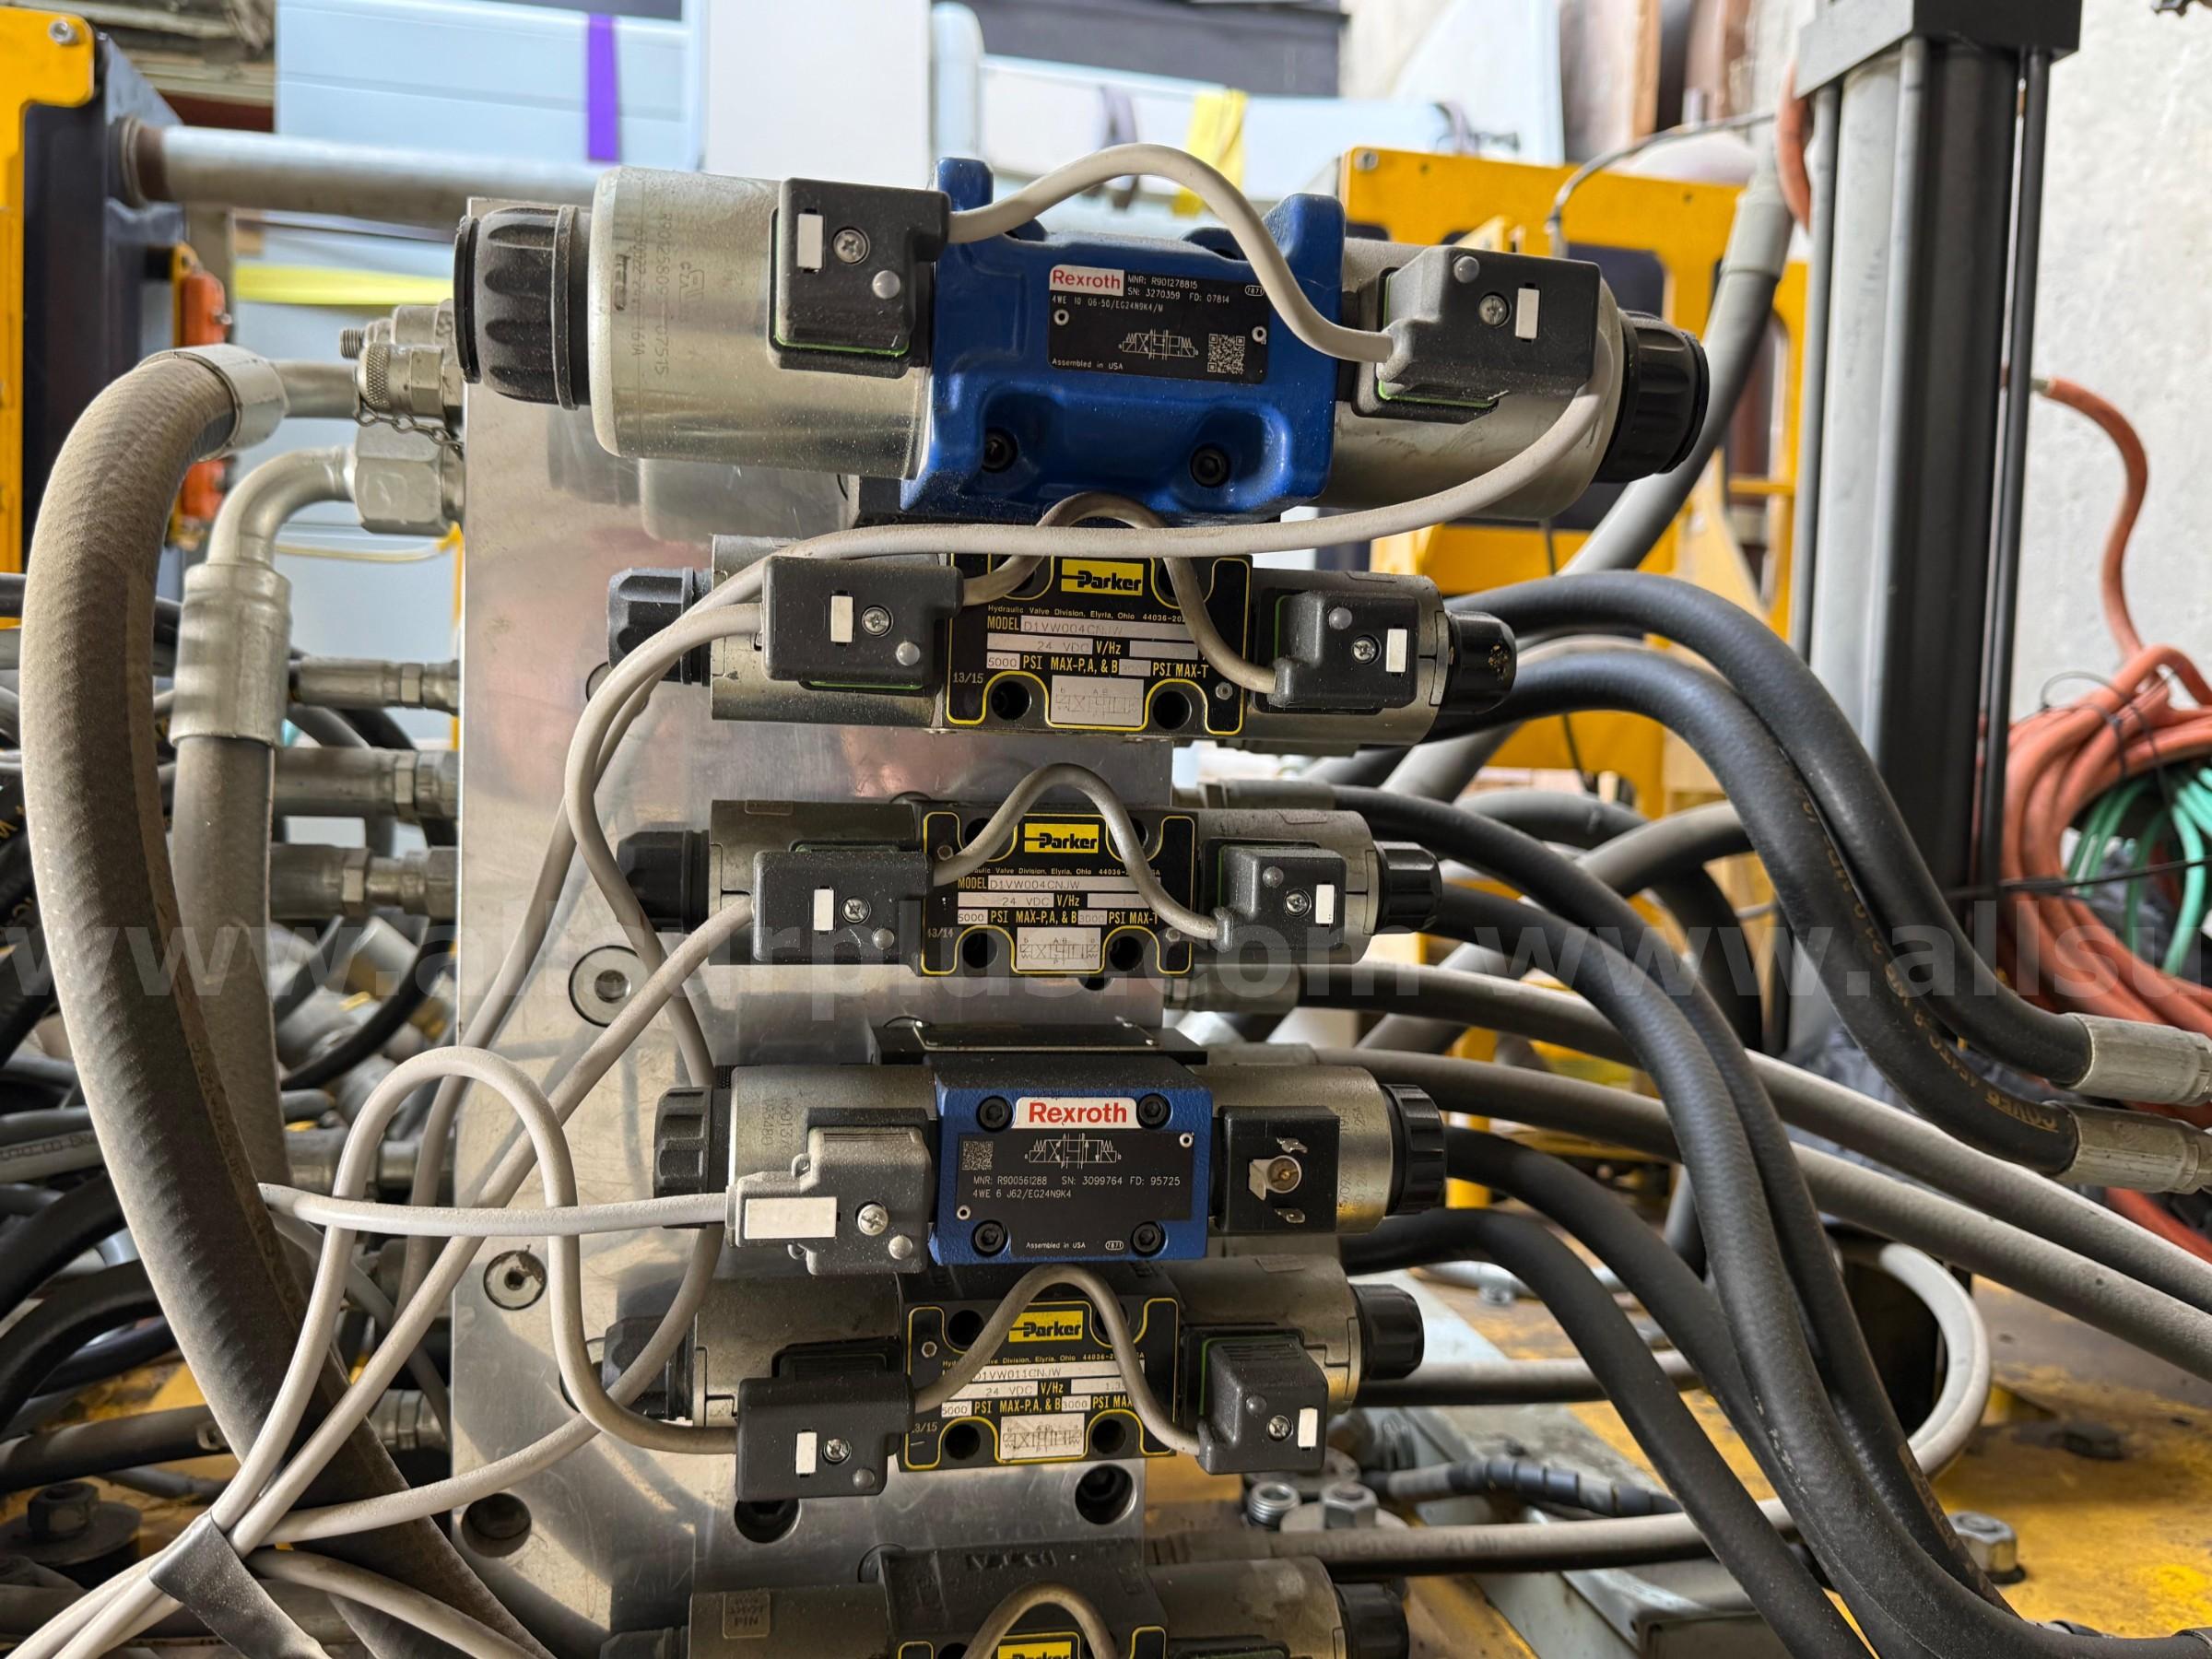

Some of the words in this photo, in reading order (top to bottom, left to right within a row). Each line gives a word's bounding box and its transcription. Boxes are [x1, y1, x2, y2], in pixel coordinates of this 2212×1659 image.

[1052, 268, 1121, 289] Rexroth
[1127, 275, 1147, 285] MNR:
[1052, 295, 1067, 304] 4WE
[1127, 287, 1140, 296] SN:
[1189, 293, 1202, 302] FD:
[1206, 294, 1230, 303] 07814
[1052, 358, 1092, 369] Assembled
[1097, 360, 1104, 369] in
[1108, 362, 1124, 371] USA
[1077, 570, 1142, 592] Parker
[988, 605, 1024, 614] Hydraulic
[1030, 607, 1050, 616] Valve
[1054, 608, 1086, 618] Division,
[1089, 611, 1114, 620] Elyria,
[1117, 612, 1135, 620] Ohio
[987, 616, 1020, 631] MODEL
[1037, 641, 1052, 651] 24
[1063, 642, 1089, 653] VDC
[1096, 640, 1122, 655] V/Hz
[988, 657, 1018, 668] 5000
[1023, 654, 1043, 670] PSI
[1100, 658, 1108, 673] &
[1112, 659, 1119, 674] B
[1152, 662, 1171, 677] PSI
[1175, 663, 1209, 678] MAX-T
[952, 672, 984, 684] 13/15
[1038, 832, 1099, 850] Parker
[959, 877, 987, 889] MODEL
[990, 880, 1080, 890] D1VW004CNJW
[1002, 897, 1017, 906] 24
[1026, 897, 1050, 907] VDC
[1057, 894, 1080, 907] V/Hz
[958, 913, 984, 922] 5000
[991, 911, 1008, 924] PSI
[1061, 911, 1068, 924] &
[1071, 911, 1077, 923] B
[1109, 912, 1125, 924] PSI
[1129, 911, 1159, 924] MAX-T
[1029, 1101, 1127, 1124] Rexroth
[973, 1176, 993, 1185] MNR:
[997, 1176, 1047, 1185] R900561288
[1061, 1176, 1076, 1185] SN:
[1082, 1176, 1123, 1185] 3099764
[1130, 1176, 1145, 1185] FD:
[1150, 1177, 1181, 1186] 95725
[972, 1189, 991, 1198] 4WE
[996, 1189, 1002, 1198] 6
[1006, 1189, 1072, 1200] J62/EG24N9K4
[1023, 1321, 1083, 1338] Parker
[1082, 1353, 1114, 1361] 44036-2
[985, 1387, 999, 1396] 24
[1009, 1385, 1032, 1395] VDC
[1041, 1382, 1064, 1395] V/Hz
[942, 1406, 968, 1416] 5000
[974, 1401, 992, 1414] PSI
[1045, 1398, 1052, 1410] &
[1054, 1397, 1061, 1410] B
[1062, 1400, 1088, 1409] 3000
[1092, 1395, 1110, 1409] PSI
[1113, 1394, 1134, 1408] MAX
[911, 1422, 938, 1434] 3/15
